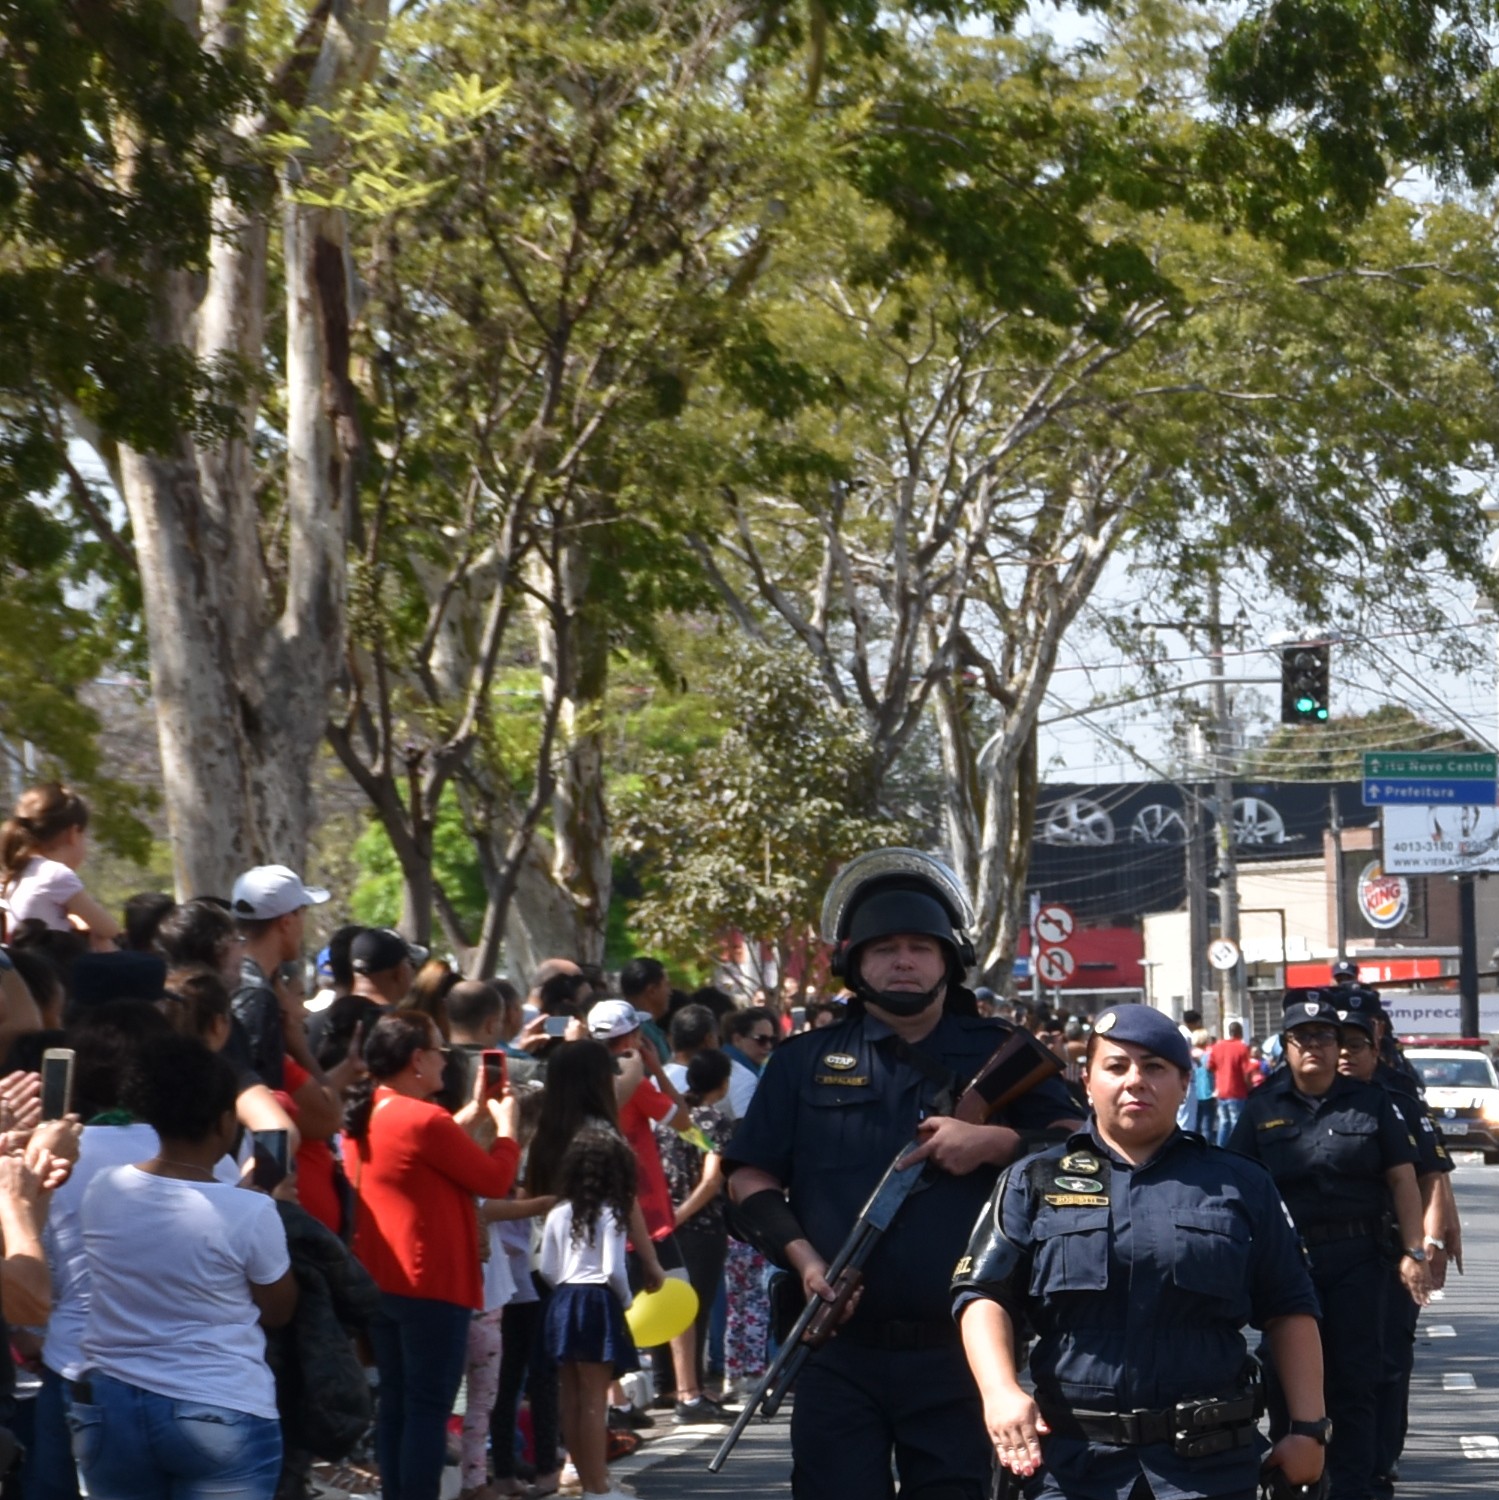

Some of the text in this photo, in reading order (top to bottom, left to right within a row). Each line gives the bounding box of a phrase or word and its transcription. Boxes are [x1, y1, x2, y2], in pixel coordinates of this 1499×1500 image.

[1409, 759, 1444, 771] Novo
[1449, 759, 1494, 771] Centro
[1385, 786, 1455, 798] Prefeitura
[1367, 882, 1401, 911] KING
[1387, 1007, 1461, 1021] ompreca
